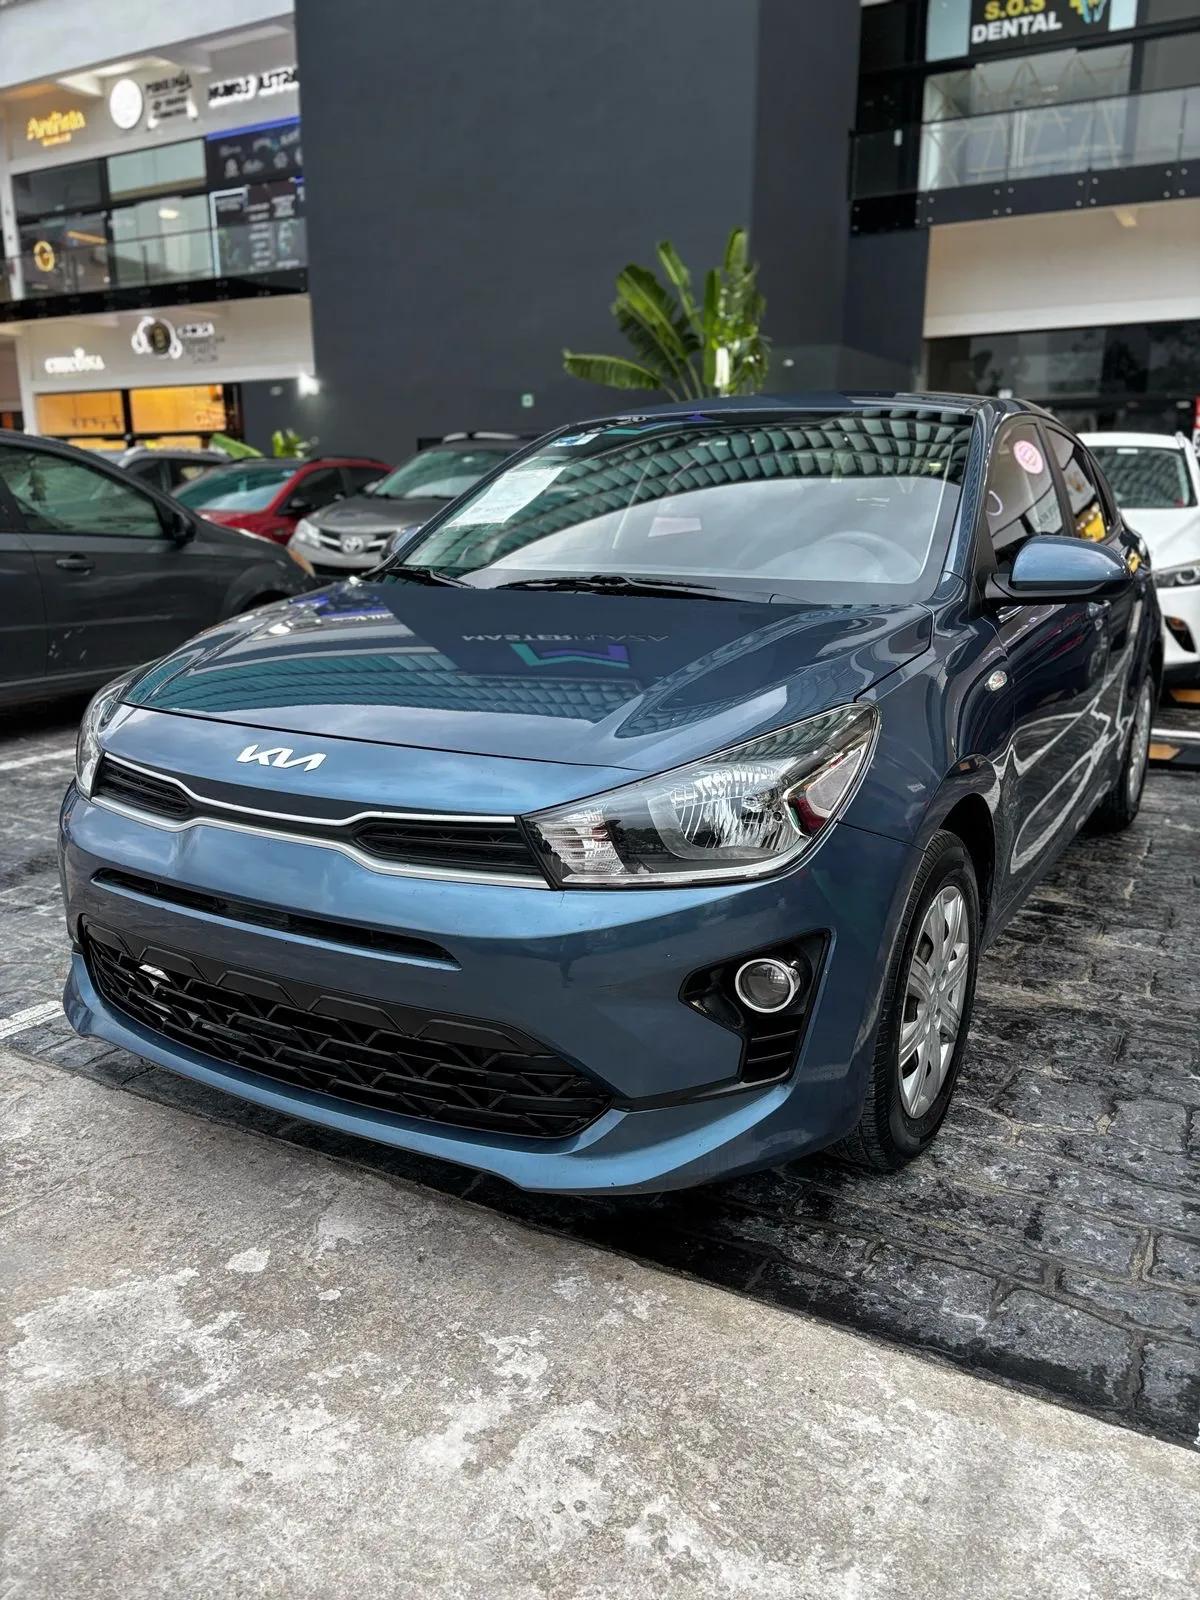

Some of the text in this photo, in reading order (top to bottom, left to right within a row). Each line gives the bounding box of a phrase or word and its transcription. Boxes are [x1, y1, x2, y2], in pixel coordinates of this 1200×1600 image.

[984, 0, 1046, 20] S.O.S
[971, 11, 1063, 44] DENTAL
[236, 744, 327, 772] KIA
